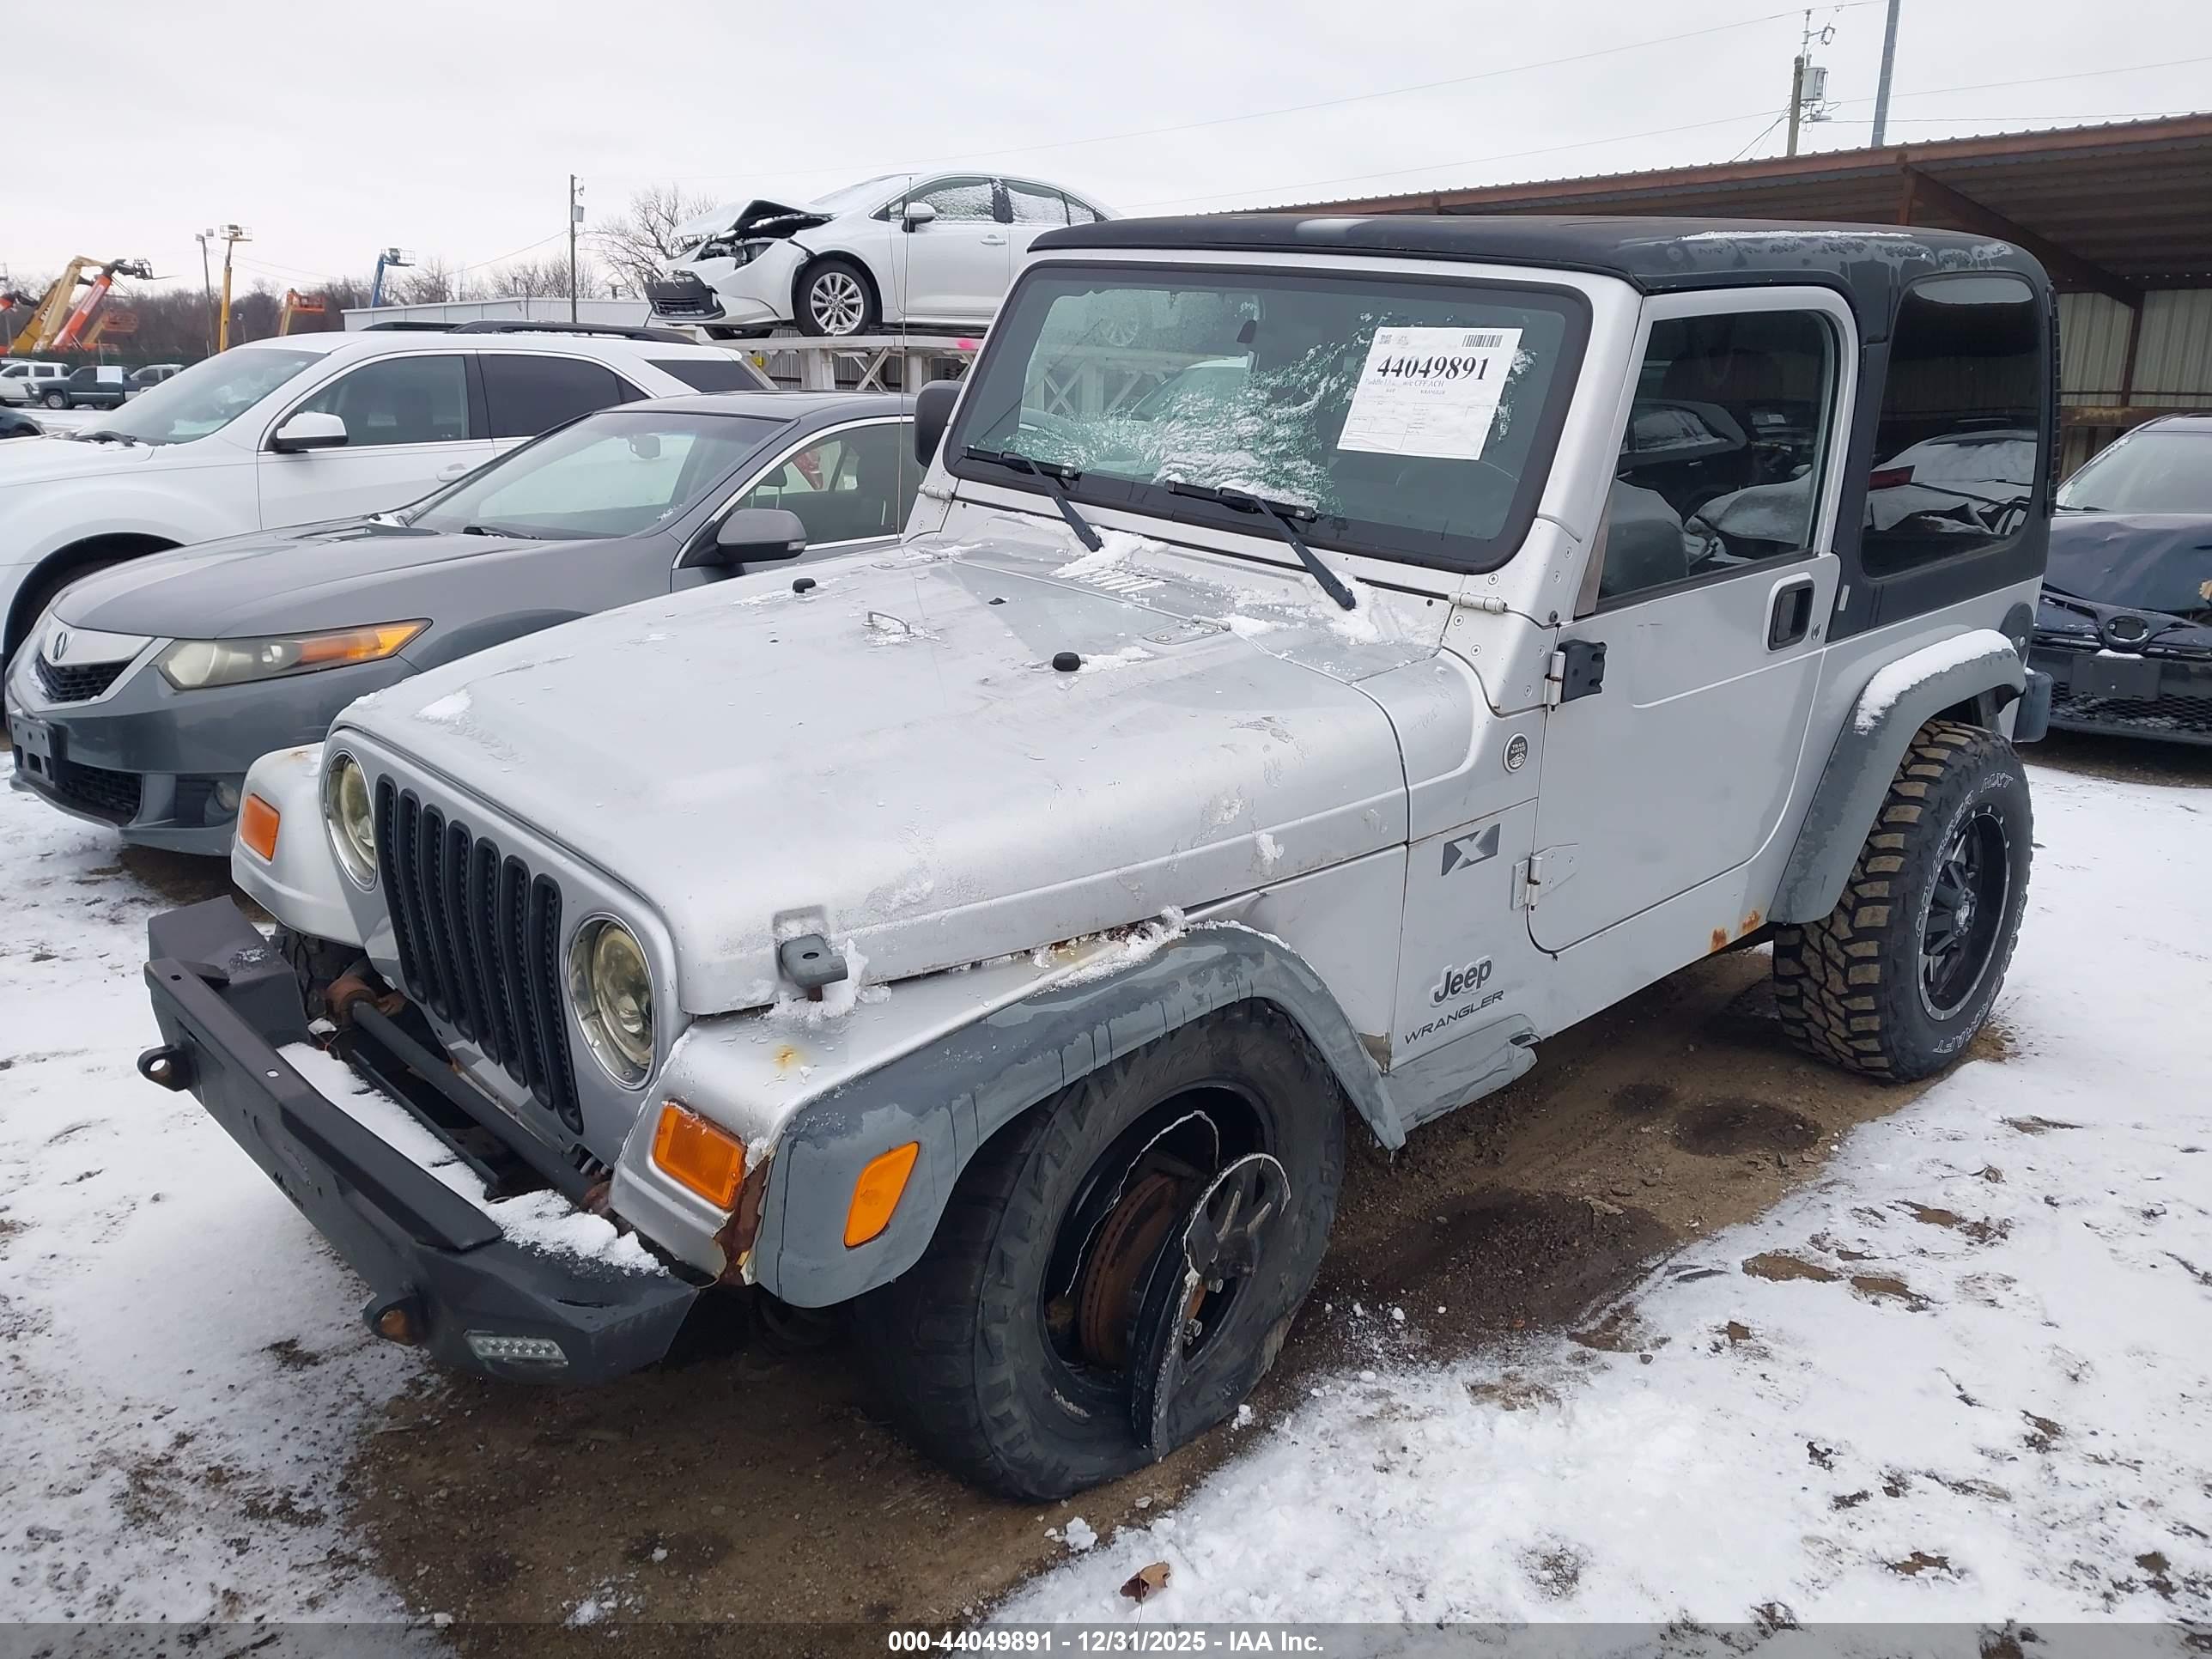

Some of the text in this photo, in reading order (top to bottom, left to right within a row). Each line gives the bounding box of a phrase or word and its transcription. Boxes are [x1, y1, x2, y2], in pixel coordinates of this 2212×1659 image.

[1376, 356, 1490, 380] 44049891
[1432, 957, 1493, 1004] Jeep
[1404, 989, 1505, 1045] WRANGLER
